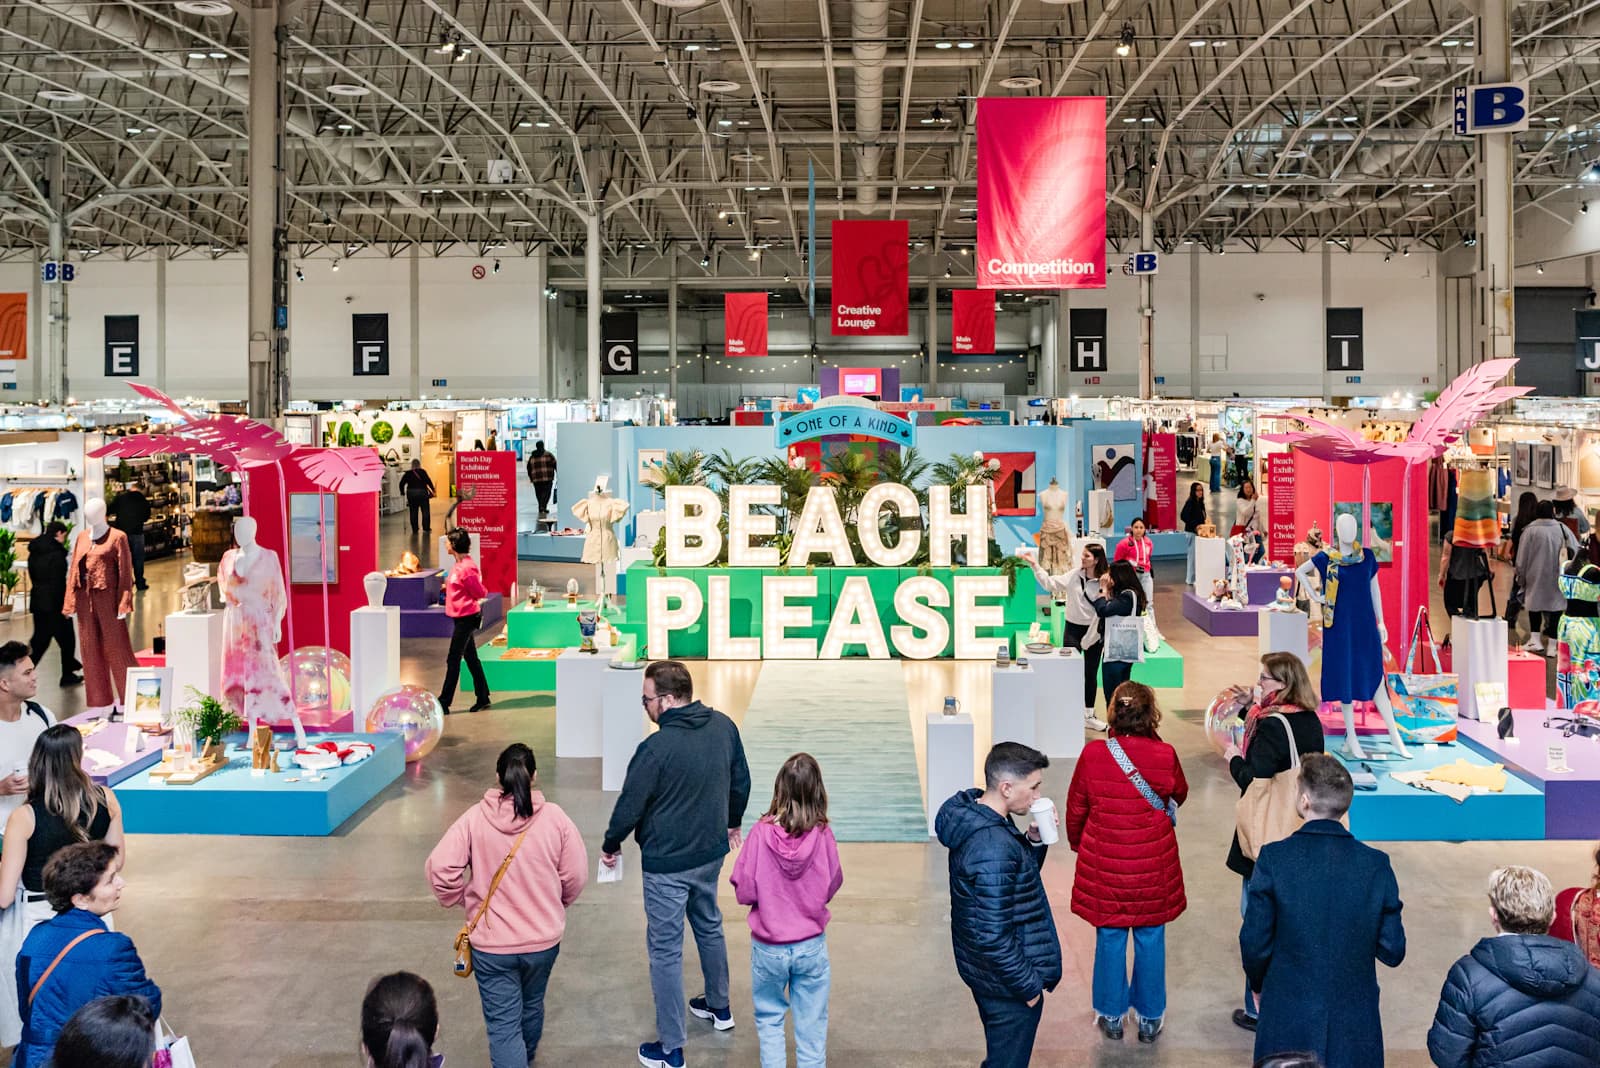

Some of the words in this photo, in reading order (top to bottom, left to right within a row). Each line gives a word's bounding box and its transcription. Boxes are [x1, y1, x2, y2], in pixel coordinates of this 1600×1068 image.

[1455, 88, 1466, 134] HALL
[1474, 86, 1526, 127] B
[45, 263, 57, 281] B
[62, 263, 75, 282] B
[987, 258, 1095, 278] Competition
[1136, 254, 1157, 272] B
[837, 304, 882, 315] Creative
[837, 318, 876, 330] Lounge
[361, 346, 381, 372] F
[607, 345, 632, 372] G
[728, 346, 746, 354] Stage
[1077, 341, 1100, 368] H
[1341, 341, 1349, 367] I
[1584, 342, 1600, 369] J
[112, 347, 133, 373] E
[796, 416, 823, 433] ONE
[829, 415, 848, 428] OF
[854, 416, 862, 427] A
[867, 416, 898, 434] KIND
[460, 455, 480, 463] Beach
[480, 455, 492, 464] Day
[1273, 456, 1294, 465] Beach
[460, 472, 500, 480] Competition
[483, 524, 504, 532] Award
[665, 483, 989, 567] BEACH
[646, 575, 1009, 660] PLEASE
